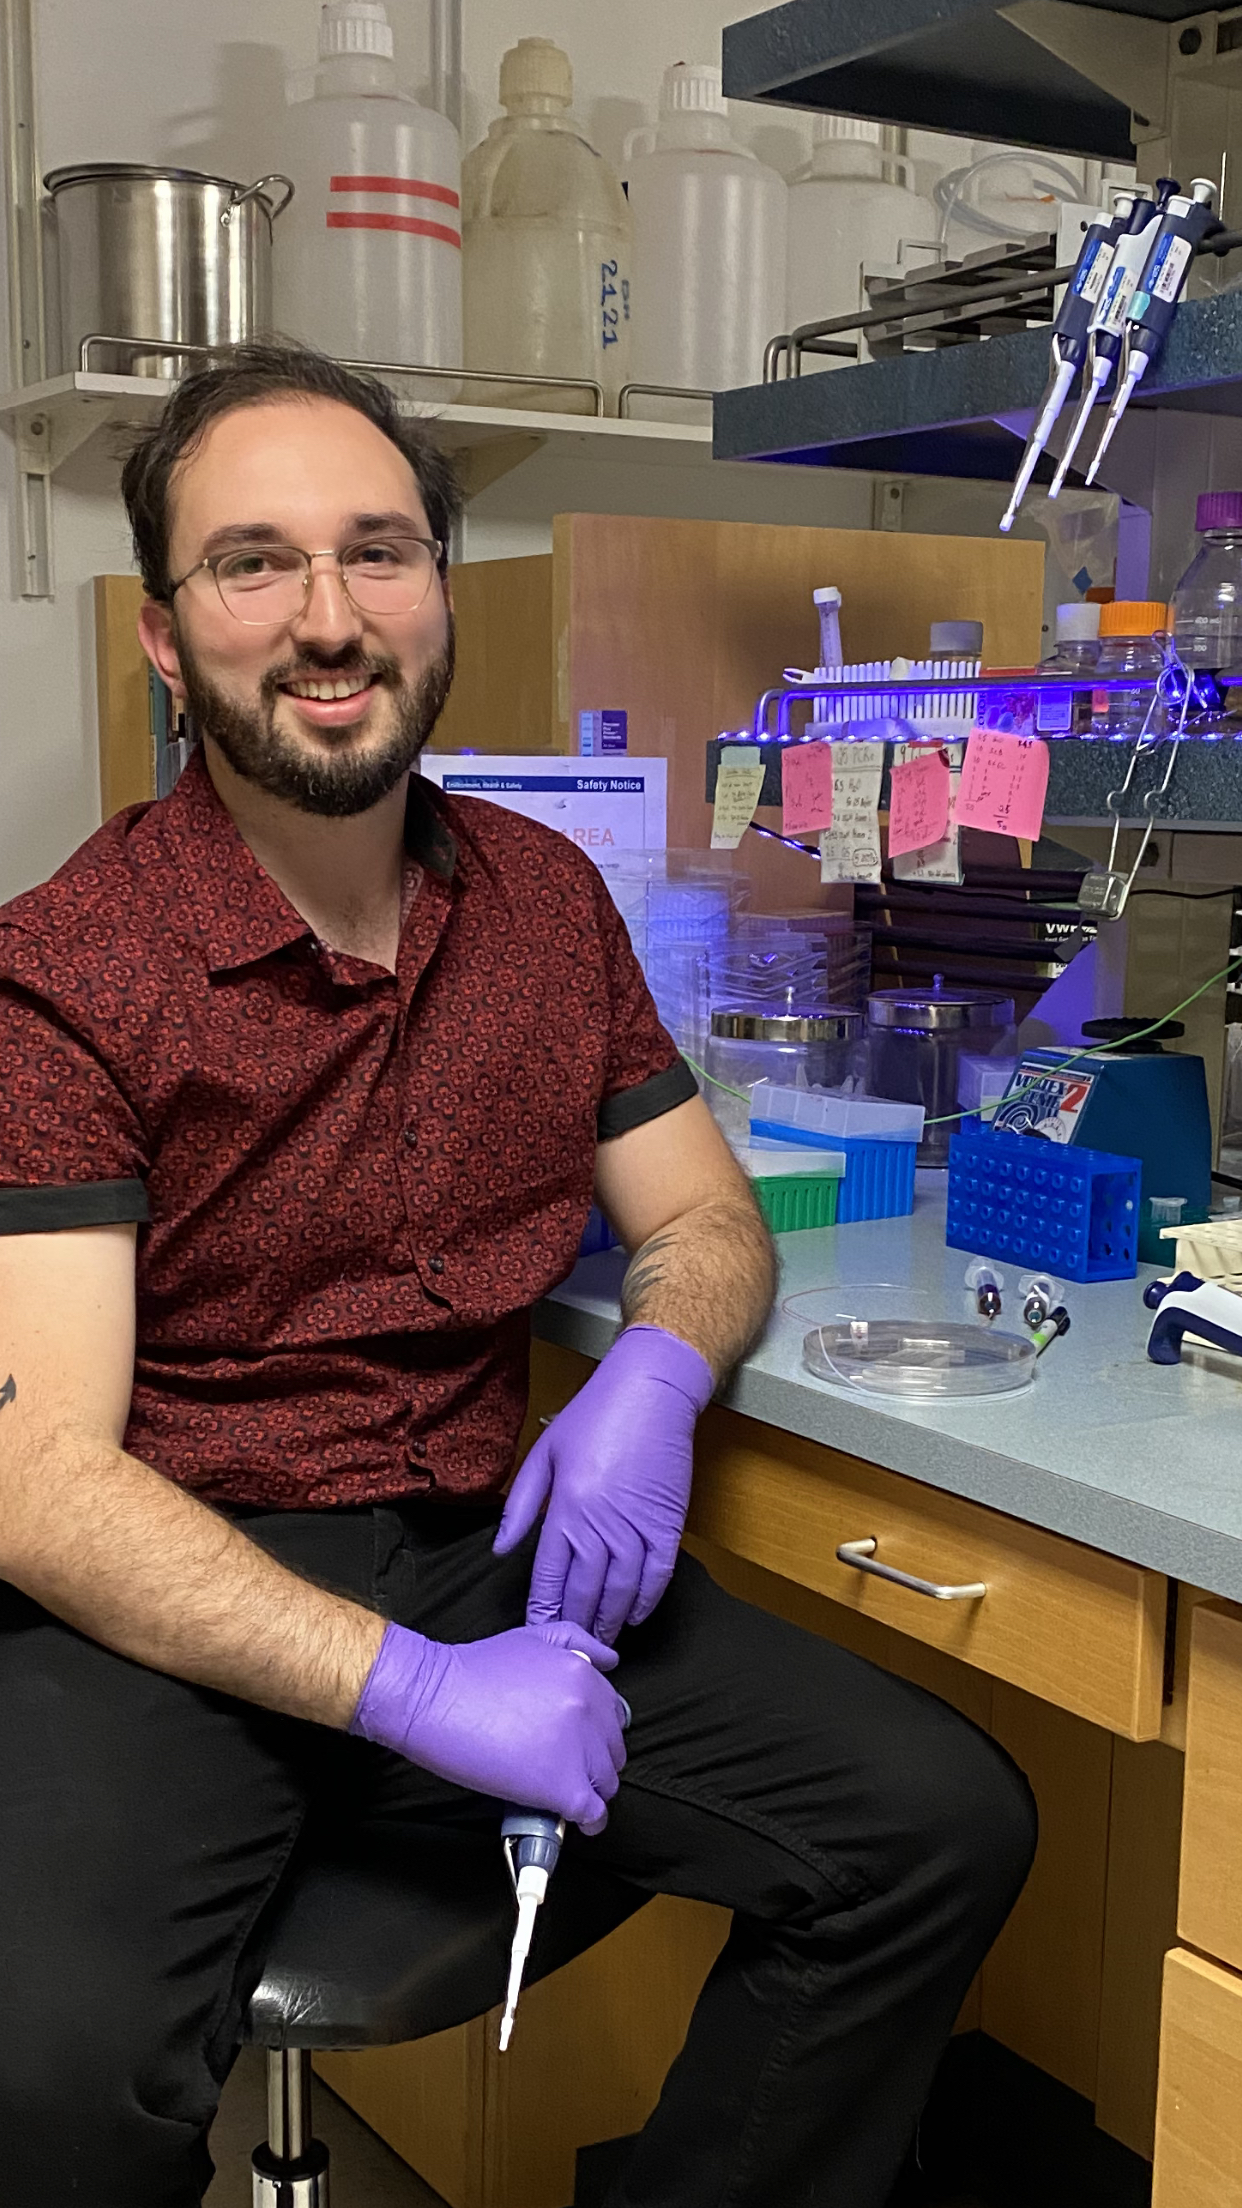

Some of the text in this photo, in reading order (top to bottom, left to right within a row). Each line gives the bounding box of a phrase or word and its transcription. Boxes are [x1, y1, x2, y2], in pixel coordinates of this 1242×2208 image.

[601, 260, 618, 350] 2121
[576, 779, 642, 792] Safety Notice
[562, 827, 616, 846] REA
[1059, 1082, 1088, 1114] 2
